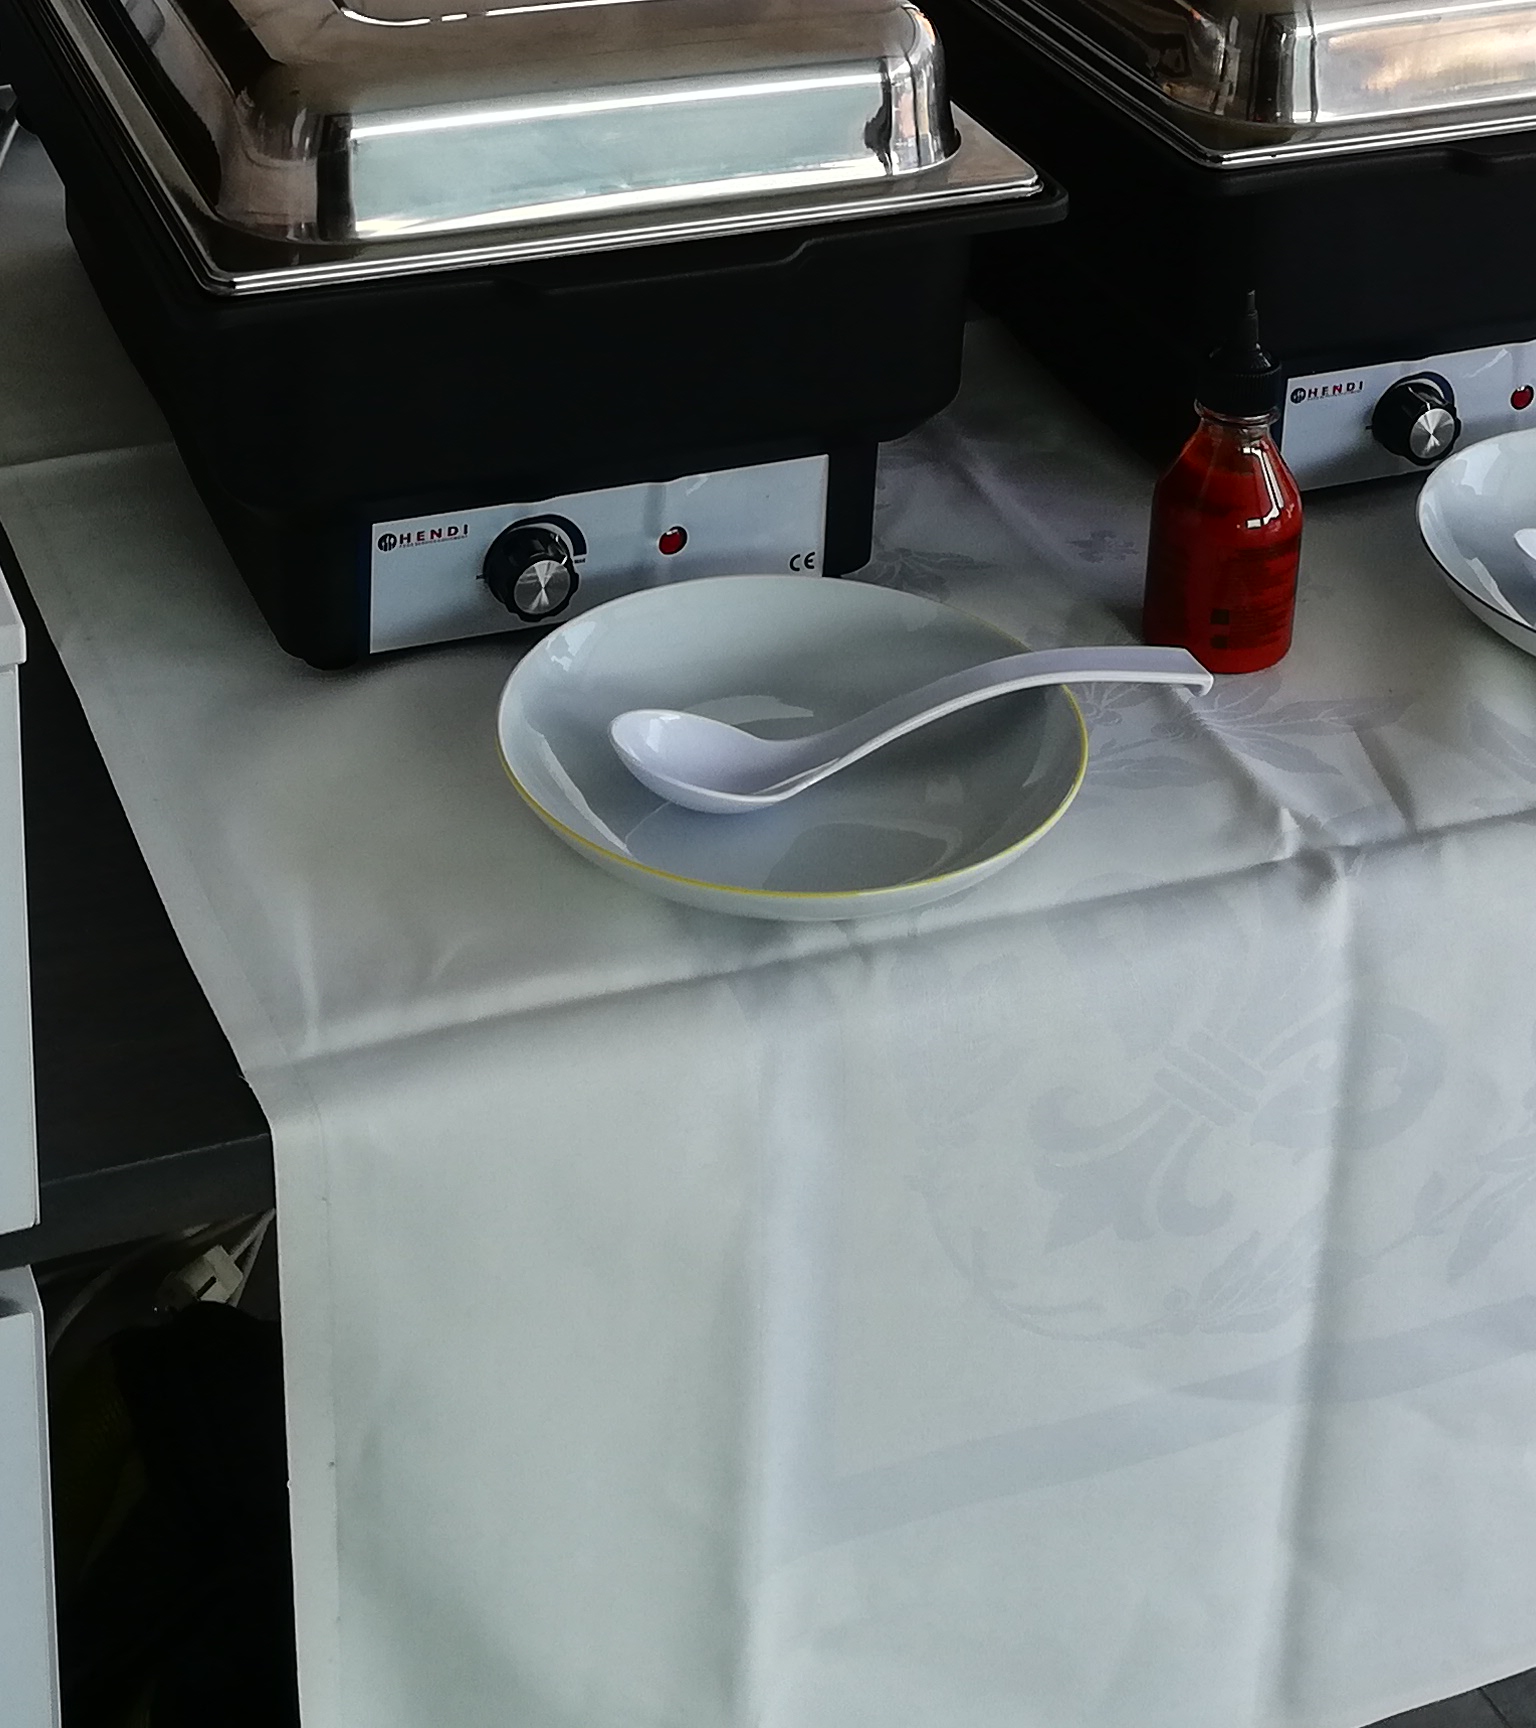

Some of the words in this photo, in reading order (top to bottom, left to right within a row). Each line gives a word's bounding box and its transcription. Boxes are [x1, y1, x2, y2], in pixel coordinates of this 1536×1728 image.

[1308, 380, 1364, 399] HENDI
[399, 524, 468, 545] HENDI
[789, 551, 816, 572] CE
